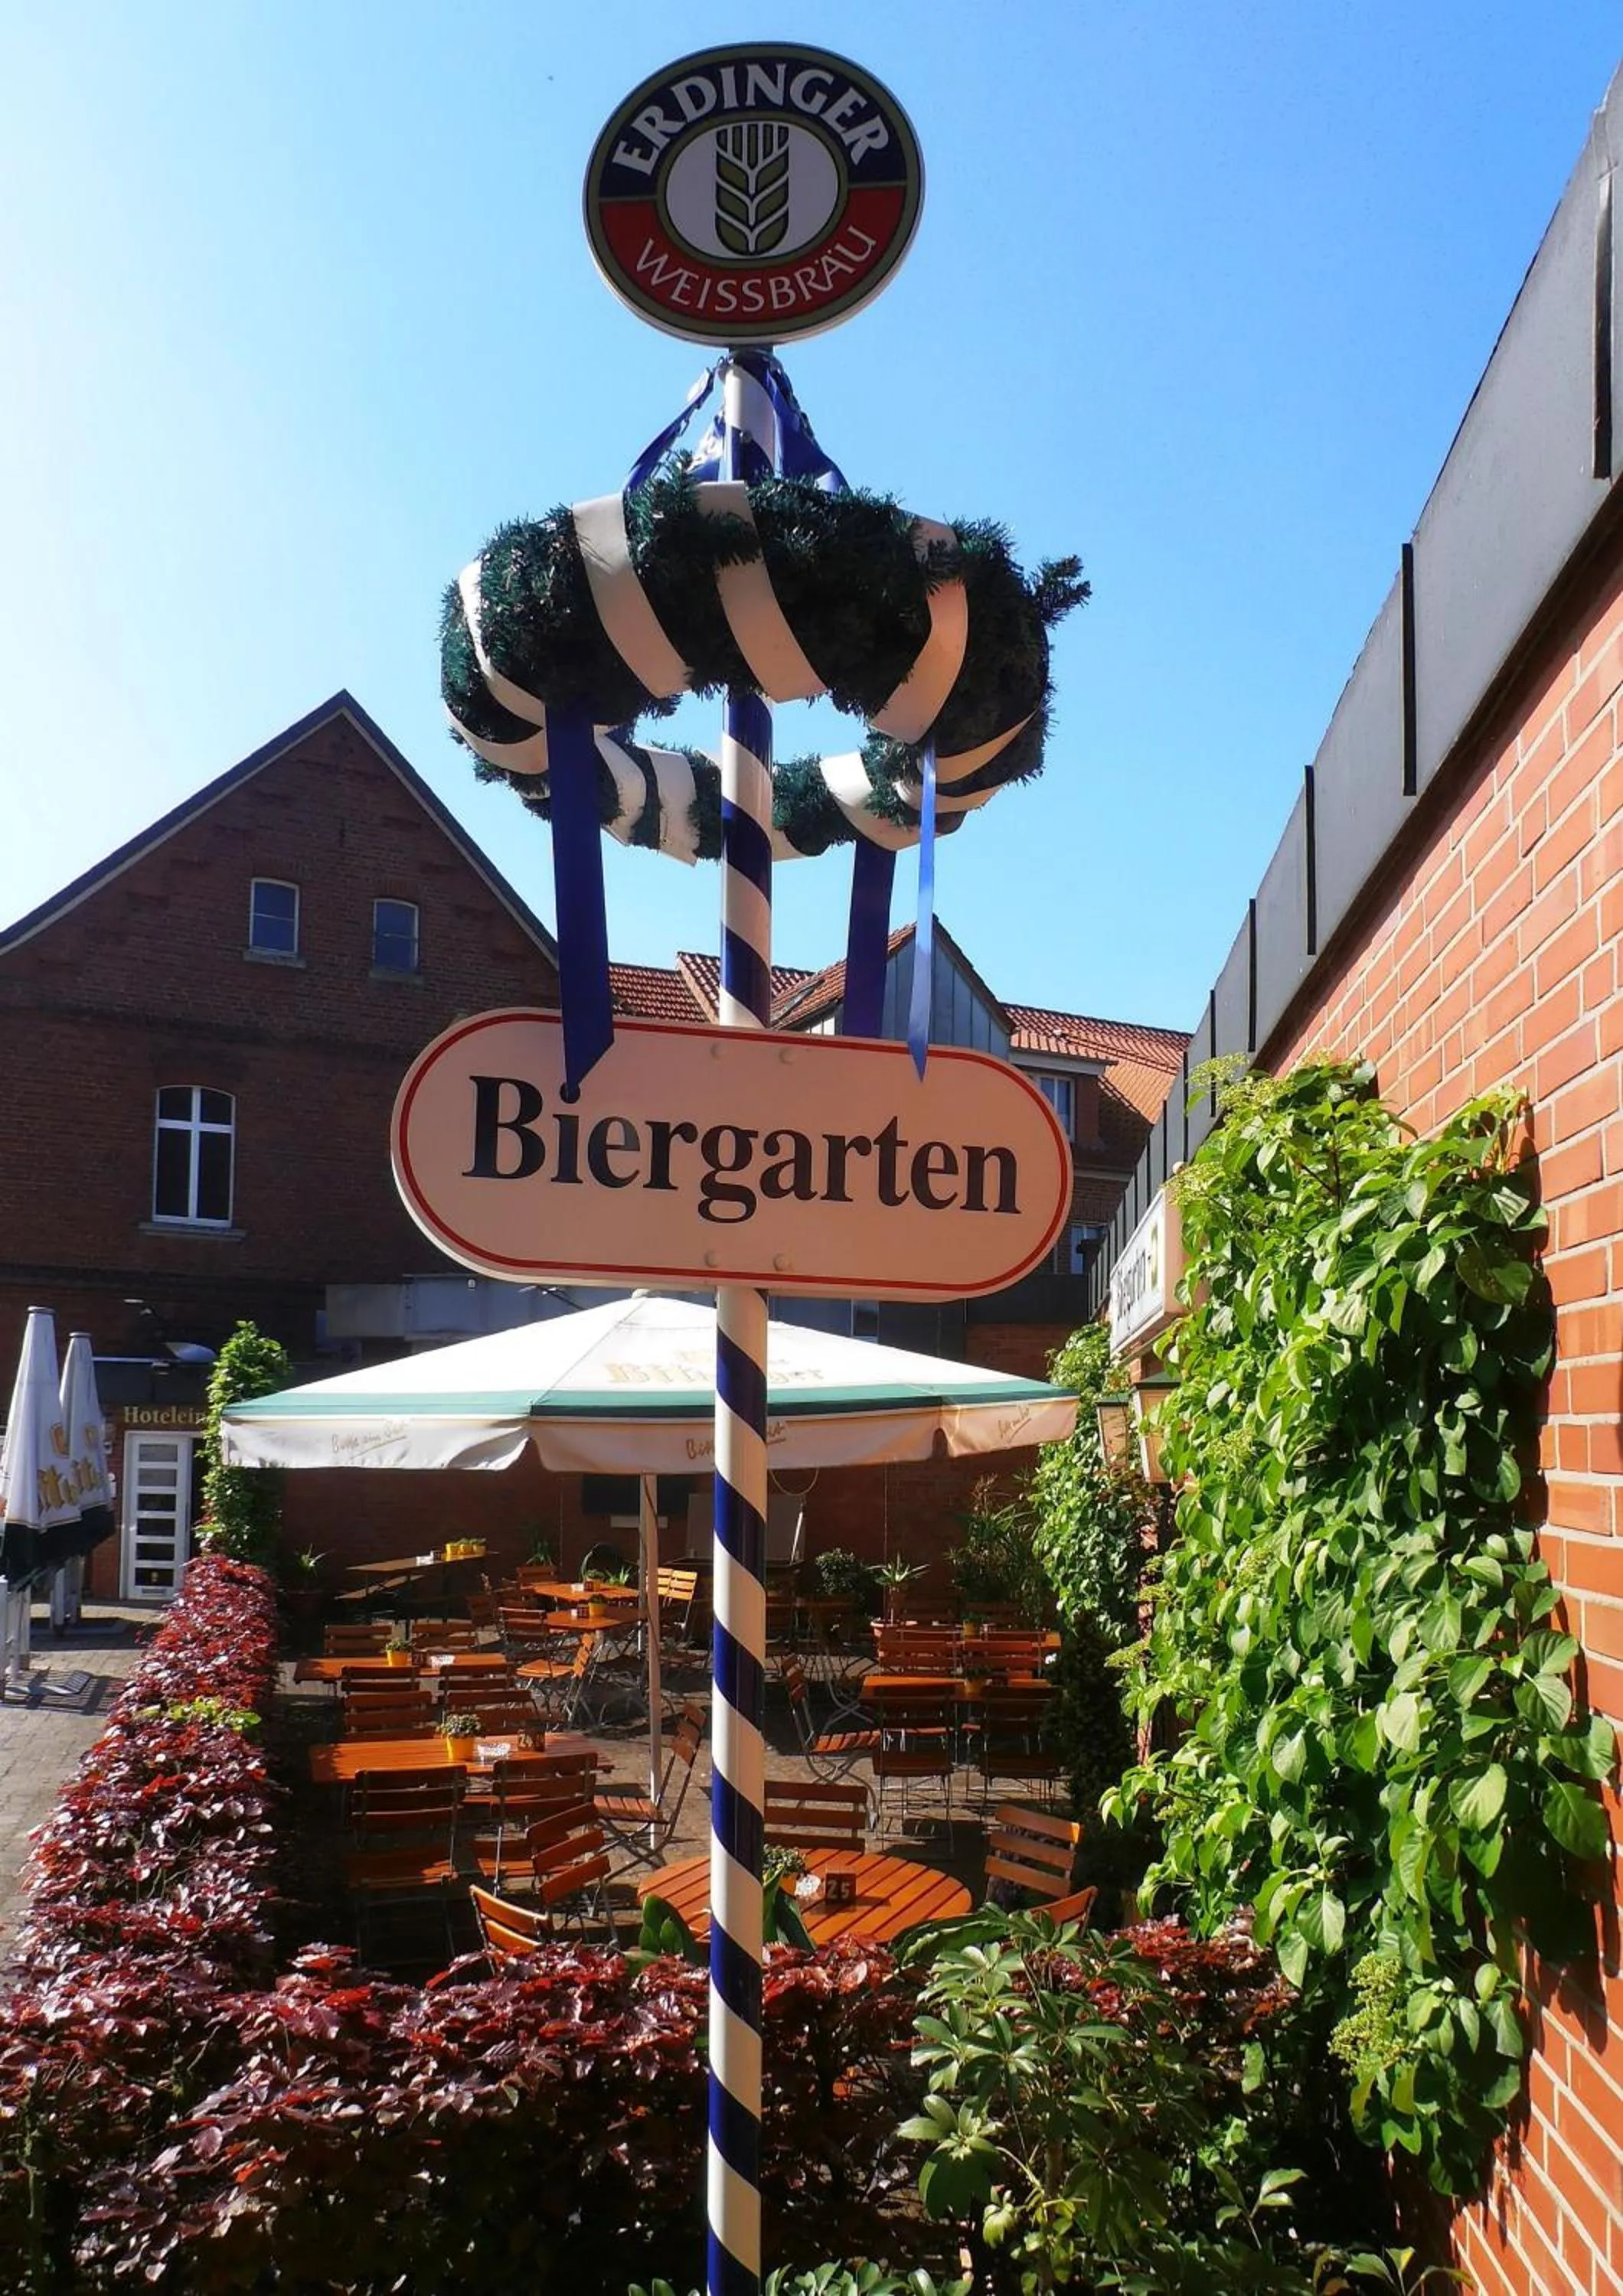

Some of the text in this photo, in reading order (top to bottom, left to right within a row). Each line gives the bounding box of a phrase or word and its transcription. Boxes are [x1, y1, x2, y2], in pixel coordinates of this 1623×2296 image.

[612, 63, 890, 176] ERDINGER
[635, 224, 877, 313] WEISSBRÄU
[462, 1075, 1022, 1223] Biergarten
[827, 1879, 850, 1899] 25
